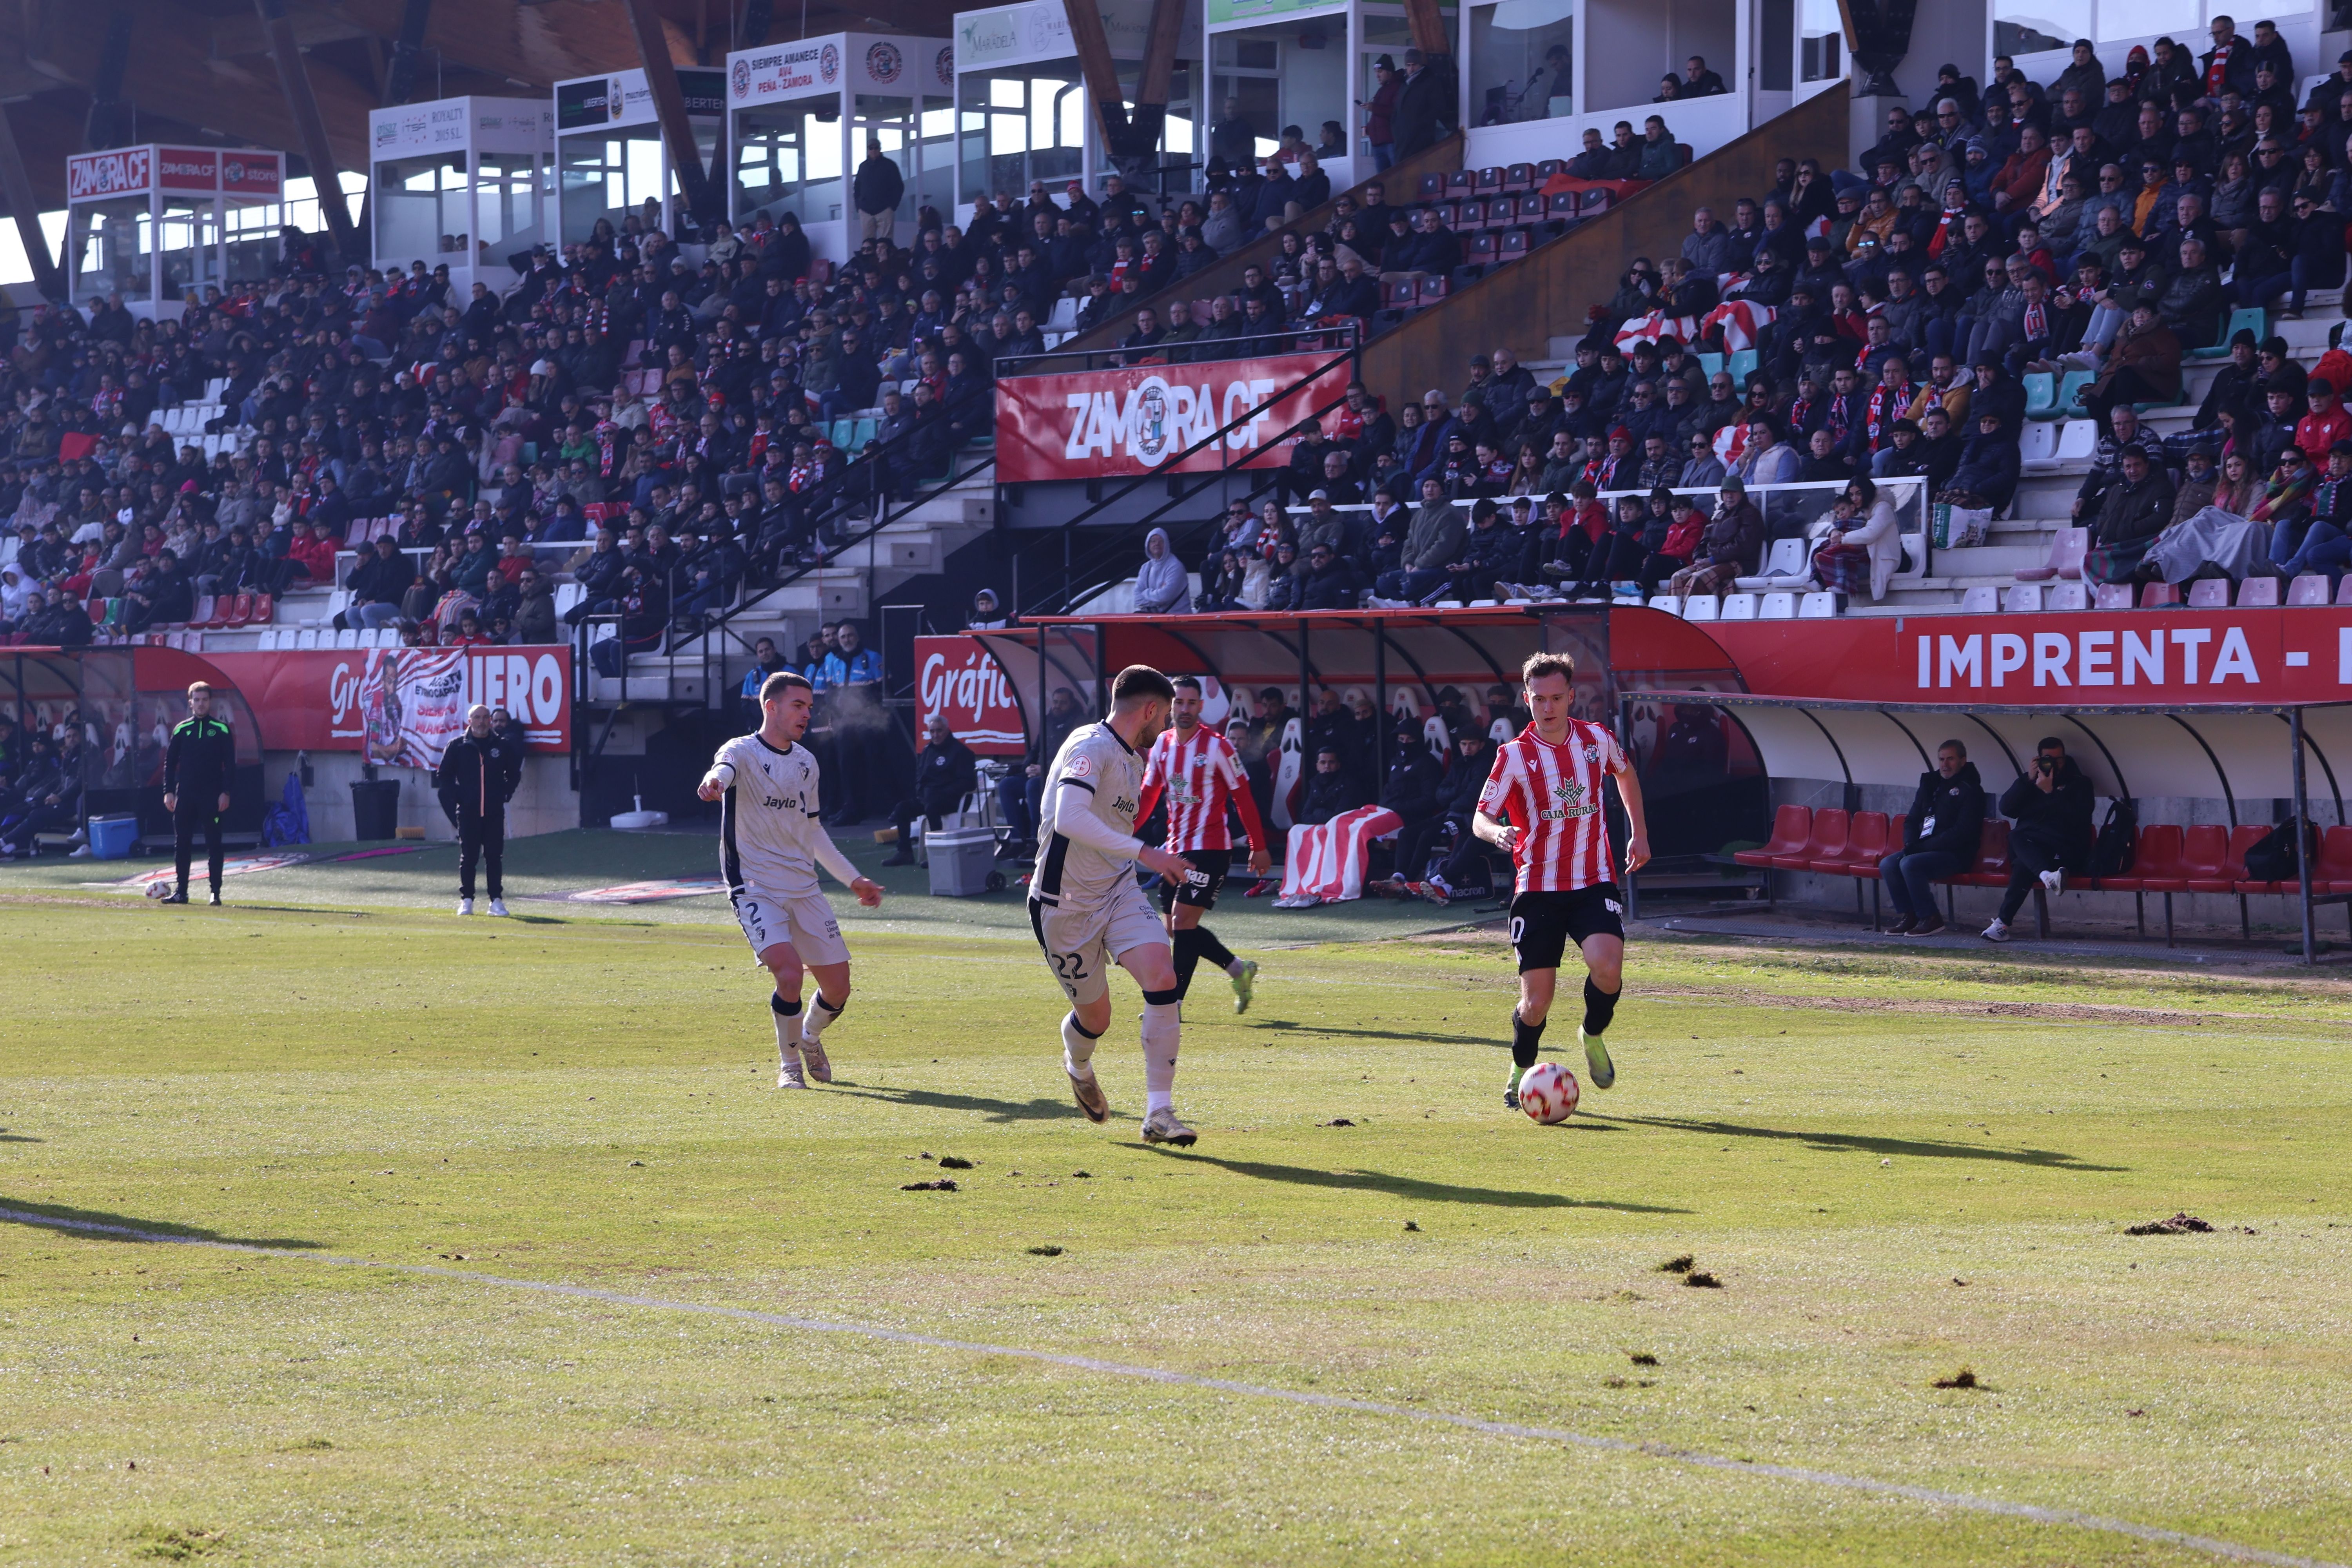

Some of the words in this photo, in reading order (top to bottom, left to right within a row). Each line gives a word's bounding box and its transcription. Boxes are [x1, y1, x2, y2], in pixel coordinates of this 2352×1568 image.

[752, 56, 783, 71] SIEMPRE
[785, 49, 819, 64] AMANECE
[758, 79, 777, 93] PEÑA
[782, 74, 813, 90] ZAMORA
[432, 108, 464, 123] ROYALTY
[128, 151, 148, 188] CF
[201, 165, 216, 176] CF
[247, 170, 278, 181] store
[1065, 376, 1220, 467] ZAMORA
[1223, 379, 1275, 450] CF
[1918, 626, 2260, 688] IMPRENTA
[922, 652, 1019, 724] Gráfic
[763, 796, 796, 810] Jaylo
[1112, 796, 1134, 813] Jaylo
[1541, 809, 1566, 820] CAJA
[1568, 803, 1598, 818] RURAL
[745, 902, 762, 926] 2
[1508, 916, 1525, 944] 0
[1051, 953, 1088, 979] 22
